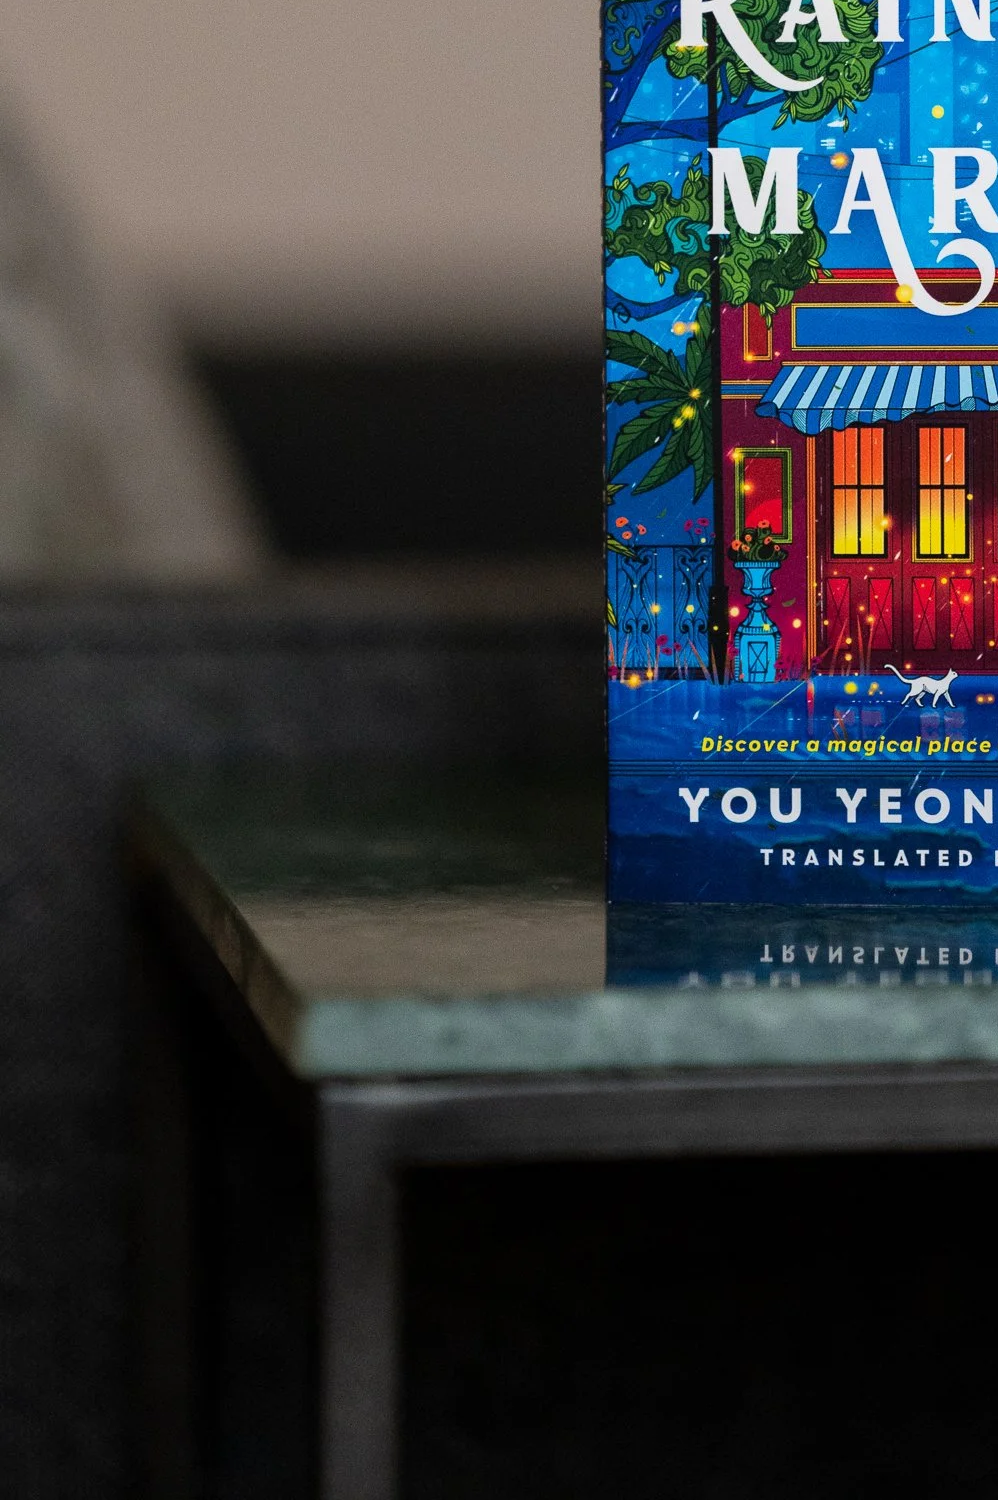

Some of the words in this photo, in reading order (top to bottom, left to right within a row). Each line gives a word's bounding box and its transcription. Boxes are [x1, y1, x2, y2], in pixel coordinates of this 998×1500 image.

[701, 735, 799, 752] Discover
[806, 740, 820, 752] a
[827, 736, 921, 756] magical
[927, 736, 991, 755] place
[678, 787, 802, 823] YOU
[760, 848, 973, 867] TRANSLATED
